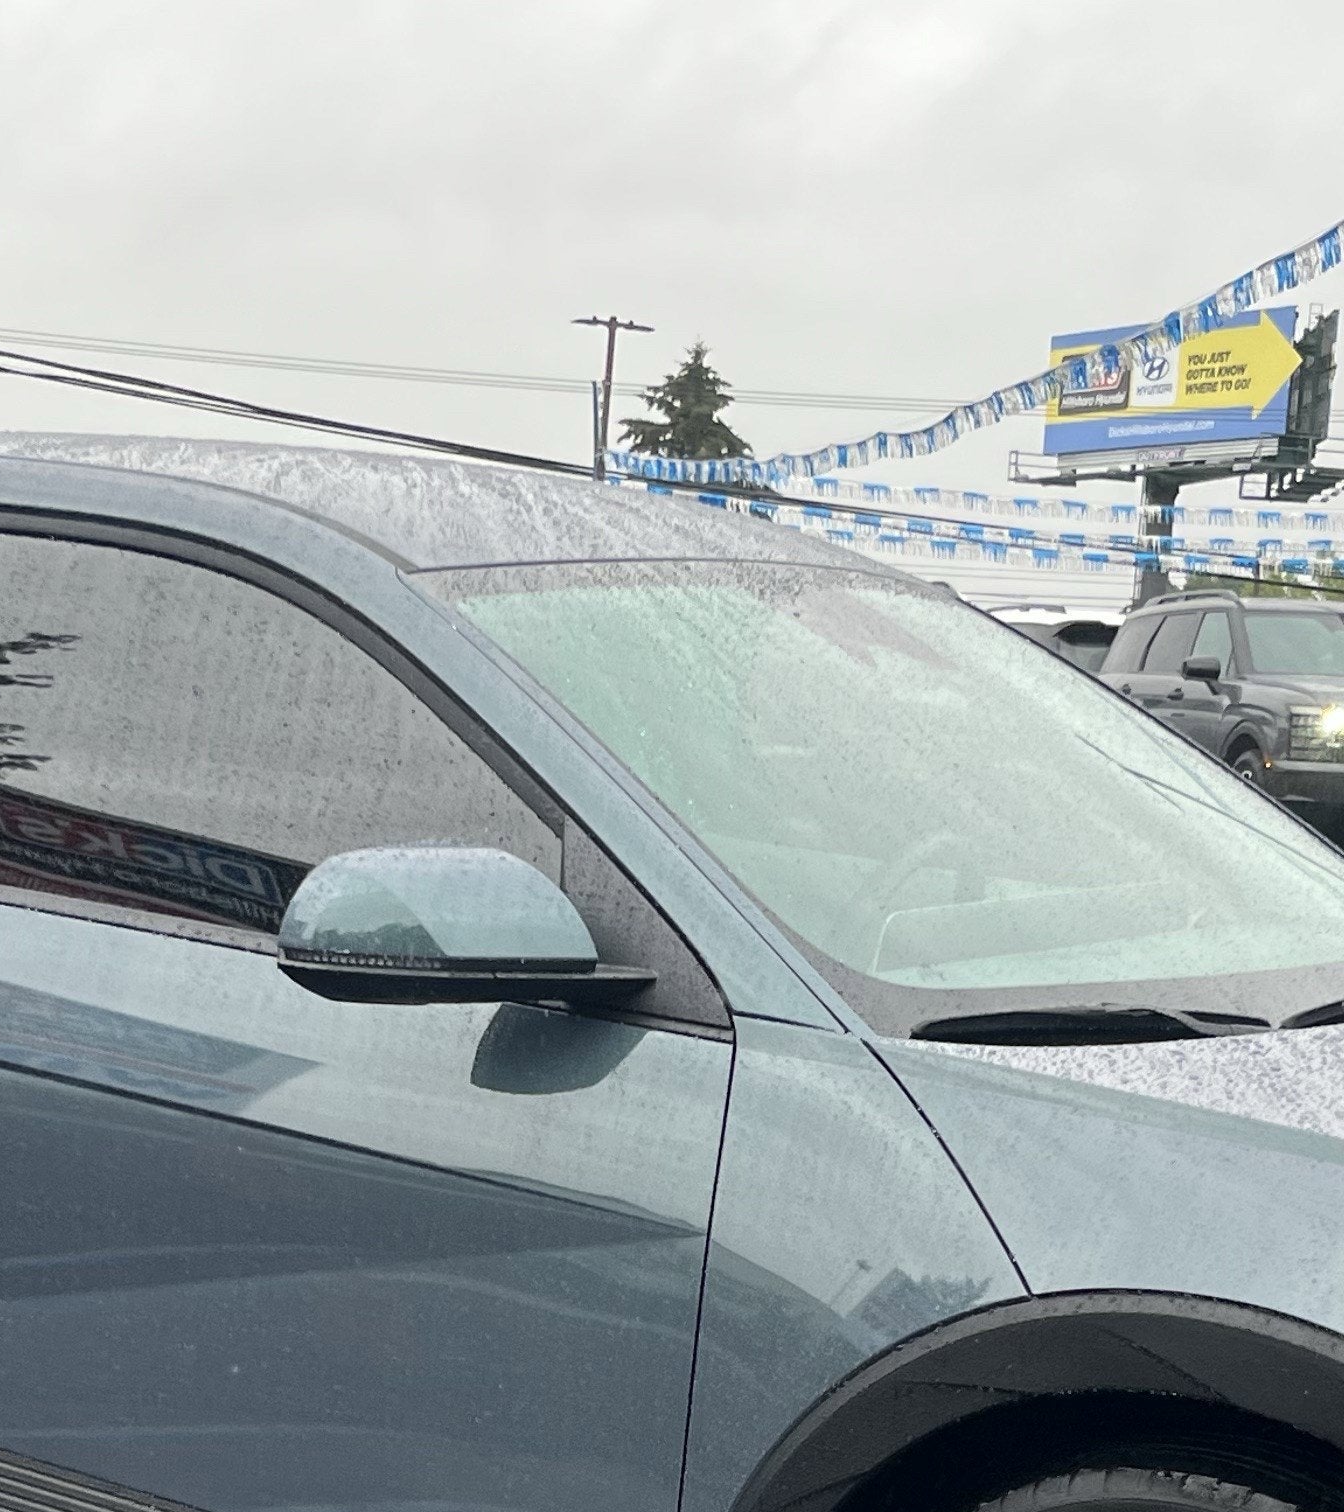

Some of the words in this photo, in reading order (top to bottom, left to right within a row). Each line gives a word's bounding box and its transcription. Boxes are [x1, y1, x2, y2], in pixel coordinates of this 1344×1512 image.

[1188, 353, 1207, 366] YOU
[1207, 350, 1231, 364] JUST
[1186, 367, 1216, 381] GOTTA
[1217, 364, 1247, 378] KNOW
[1185, 381, 1218, 395] WHERE
[1219, 379, 1233, 392] TO
[1234, 377, 1252, 390] GO!
